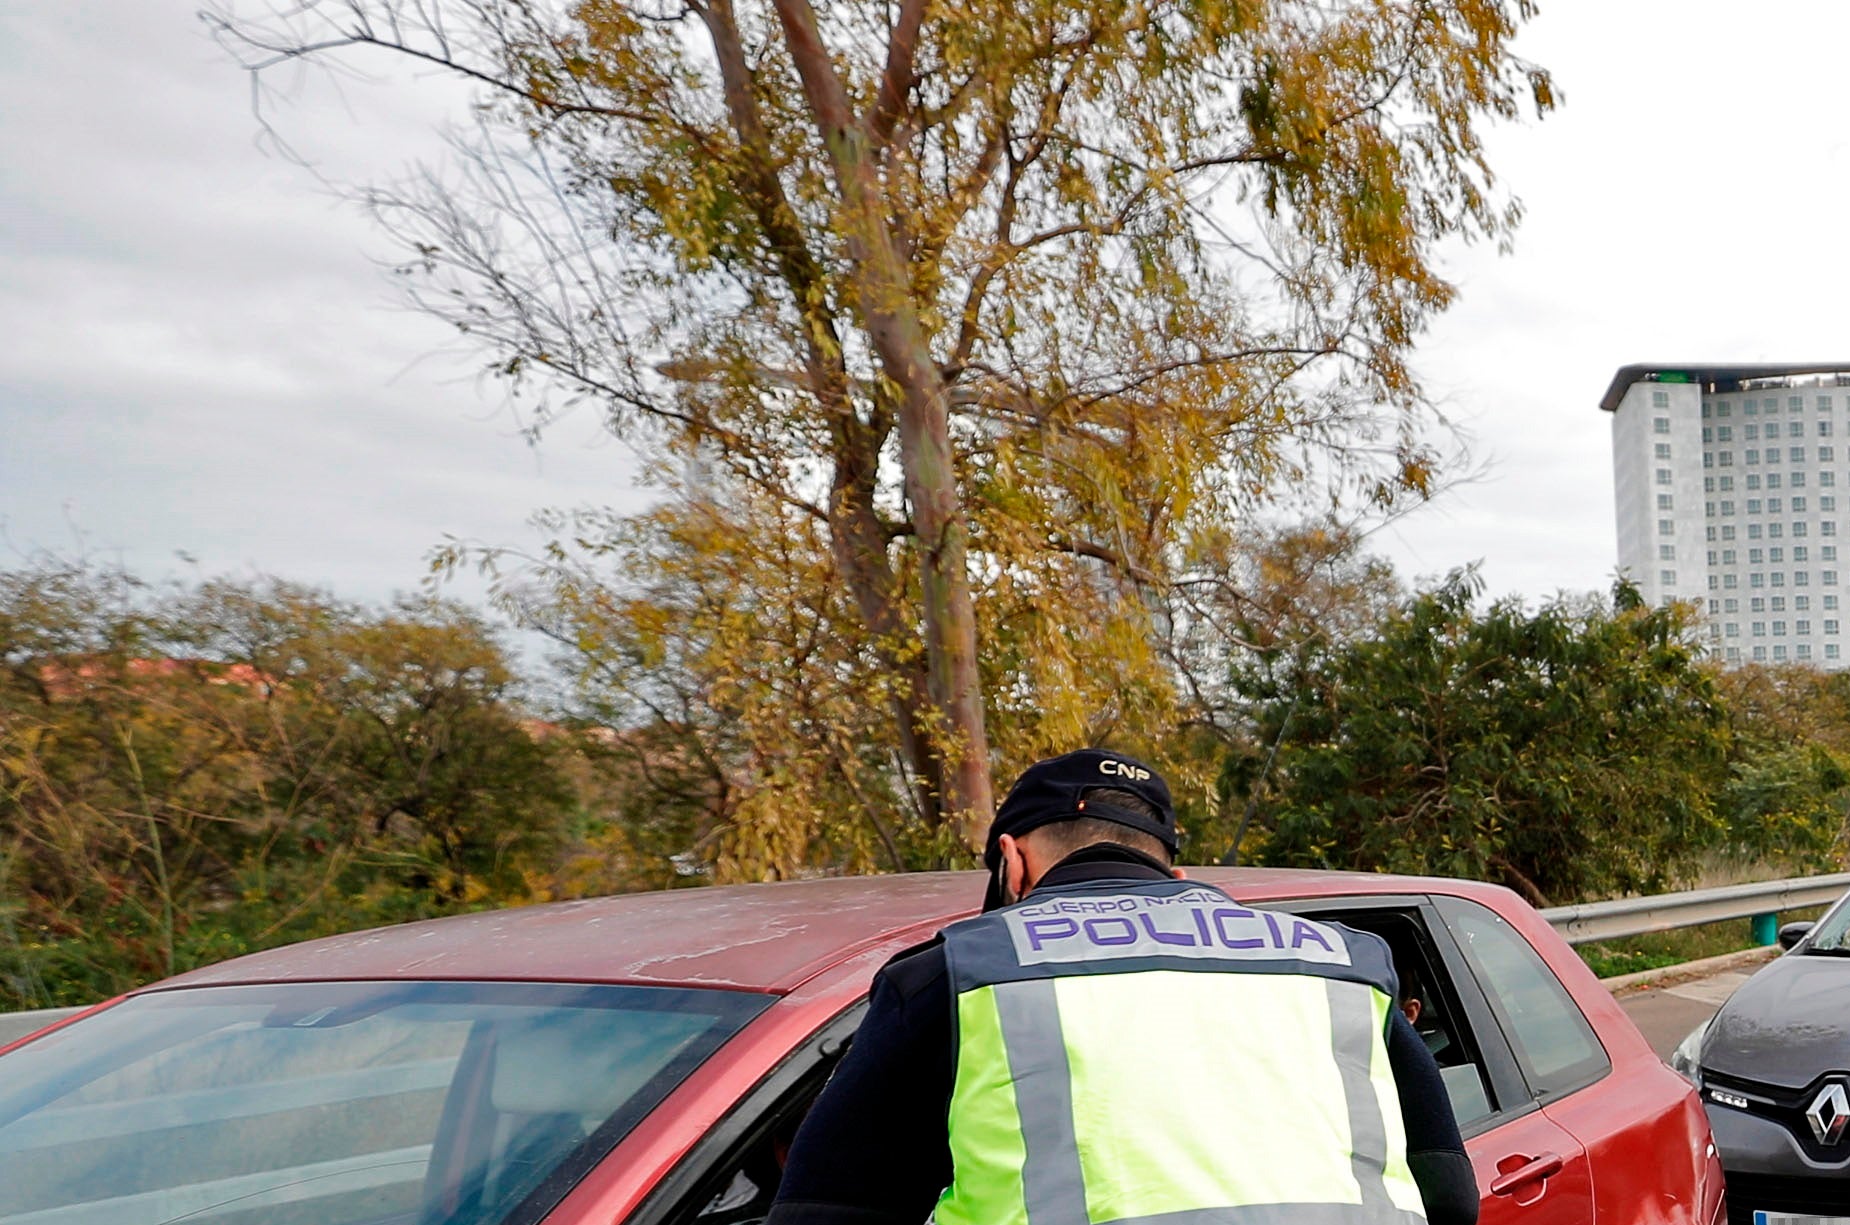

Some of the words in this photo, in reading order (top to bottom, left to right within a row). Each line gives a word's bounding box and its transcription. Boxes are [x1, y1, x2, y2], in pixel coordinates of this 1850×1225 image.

[1098, 759, 1151, 782] CNP
[1019, 898, 1137, 917] CUERPO
[1023, 907, 1335, 952] POLICIA
